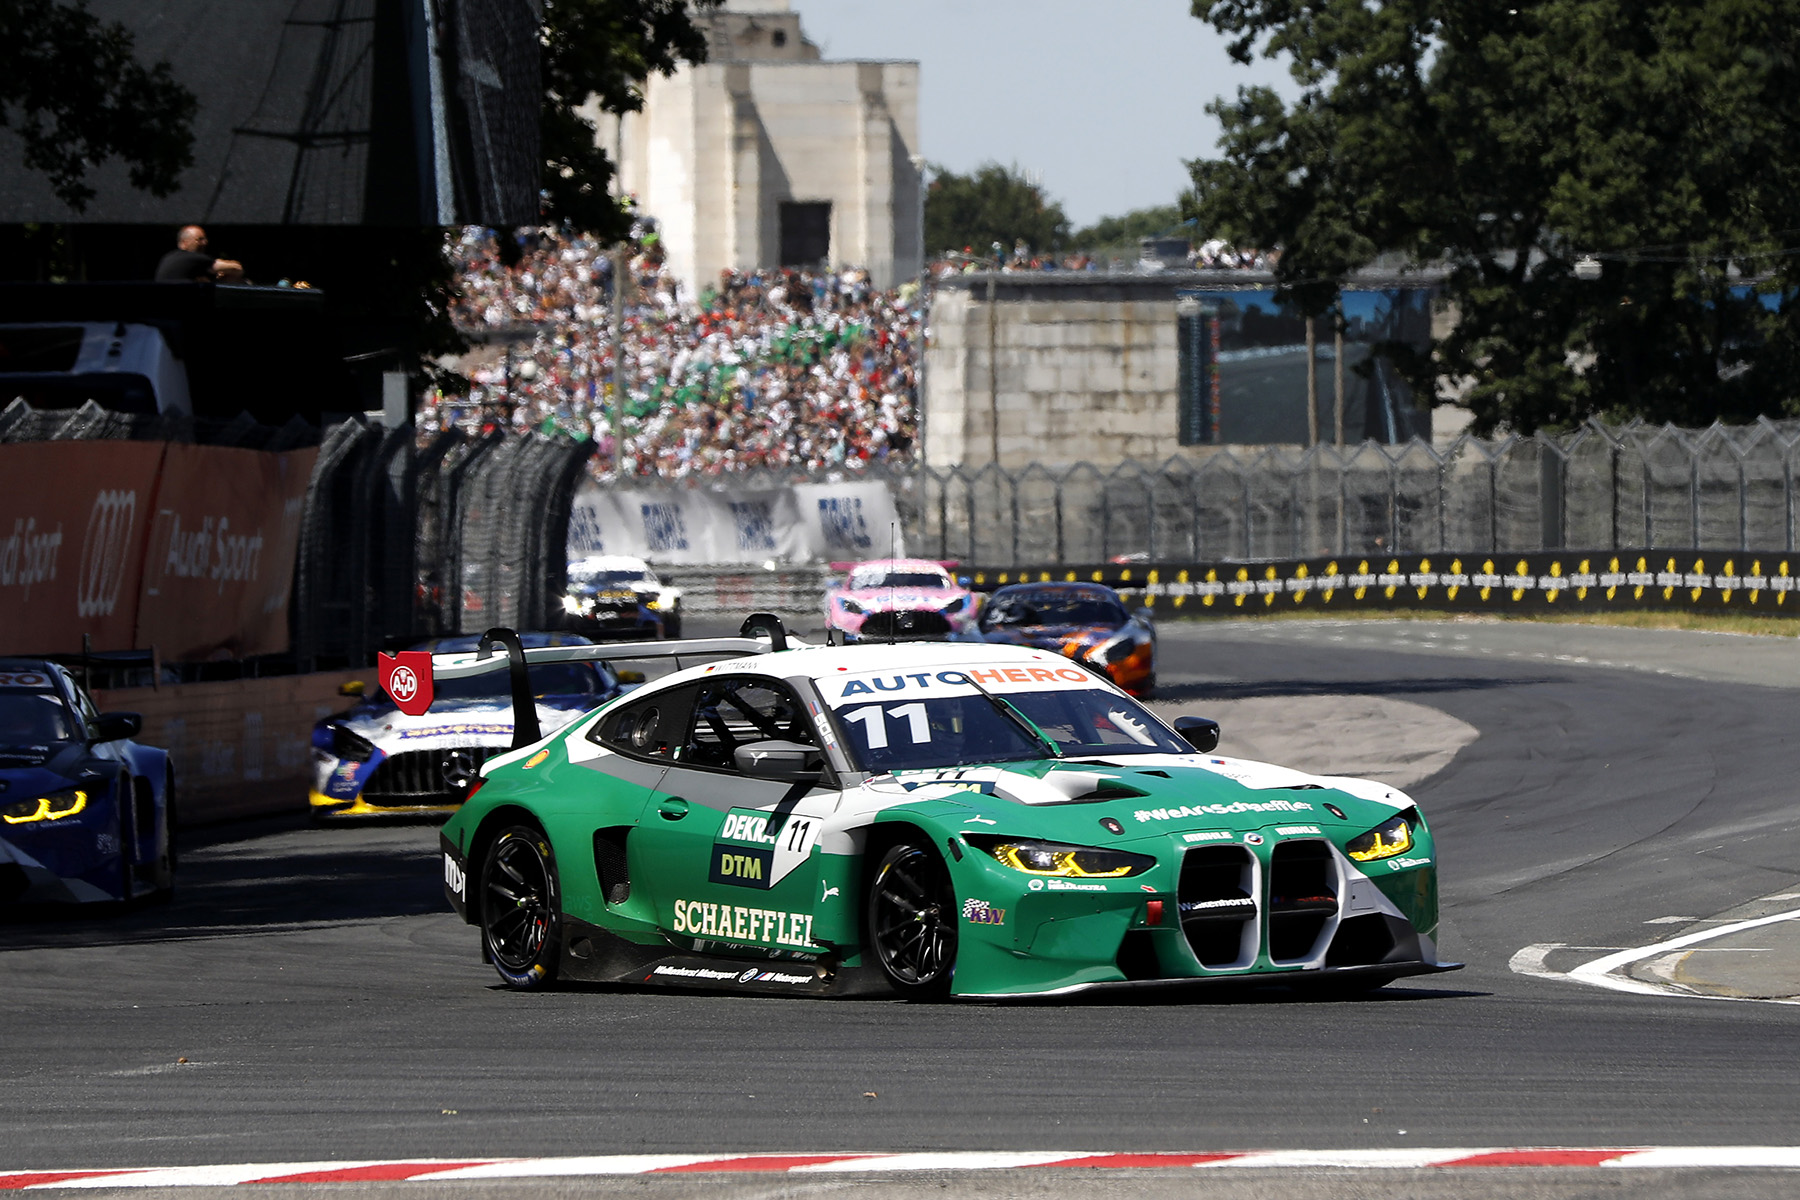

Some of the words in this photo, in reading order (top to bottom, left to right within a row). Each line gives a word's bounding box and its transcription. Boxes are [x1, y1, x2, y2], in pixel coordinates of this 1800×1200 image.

[19, 516, 62, 602] Sport
[166, 514, 213, 578] Audi
[211, 516, 263, 596] Sport
[841, 669, 1088, 698] AUTOHERO
[843, 703, 932, 750] 11
[721, 813, 776, 844] DEKRA
[787, 819, 811, 853] 11
[1182, 831, 1233, 842] MAHLE
[1274, 826, 1322, 836] MAHLE
[720, 853, 762, 880] DTM
[969, 907, 1006, 926] KW
[1179, 897, 1253, 911] Walkenhorst
[653, 965, 699, 977] Walkenhorst
[695, 968, 739, 980] Motorsport
[771, 972, 813, 984] Motorsport
